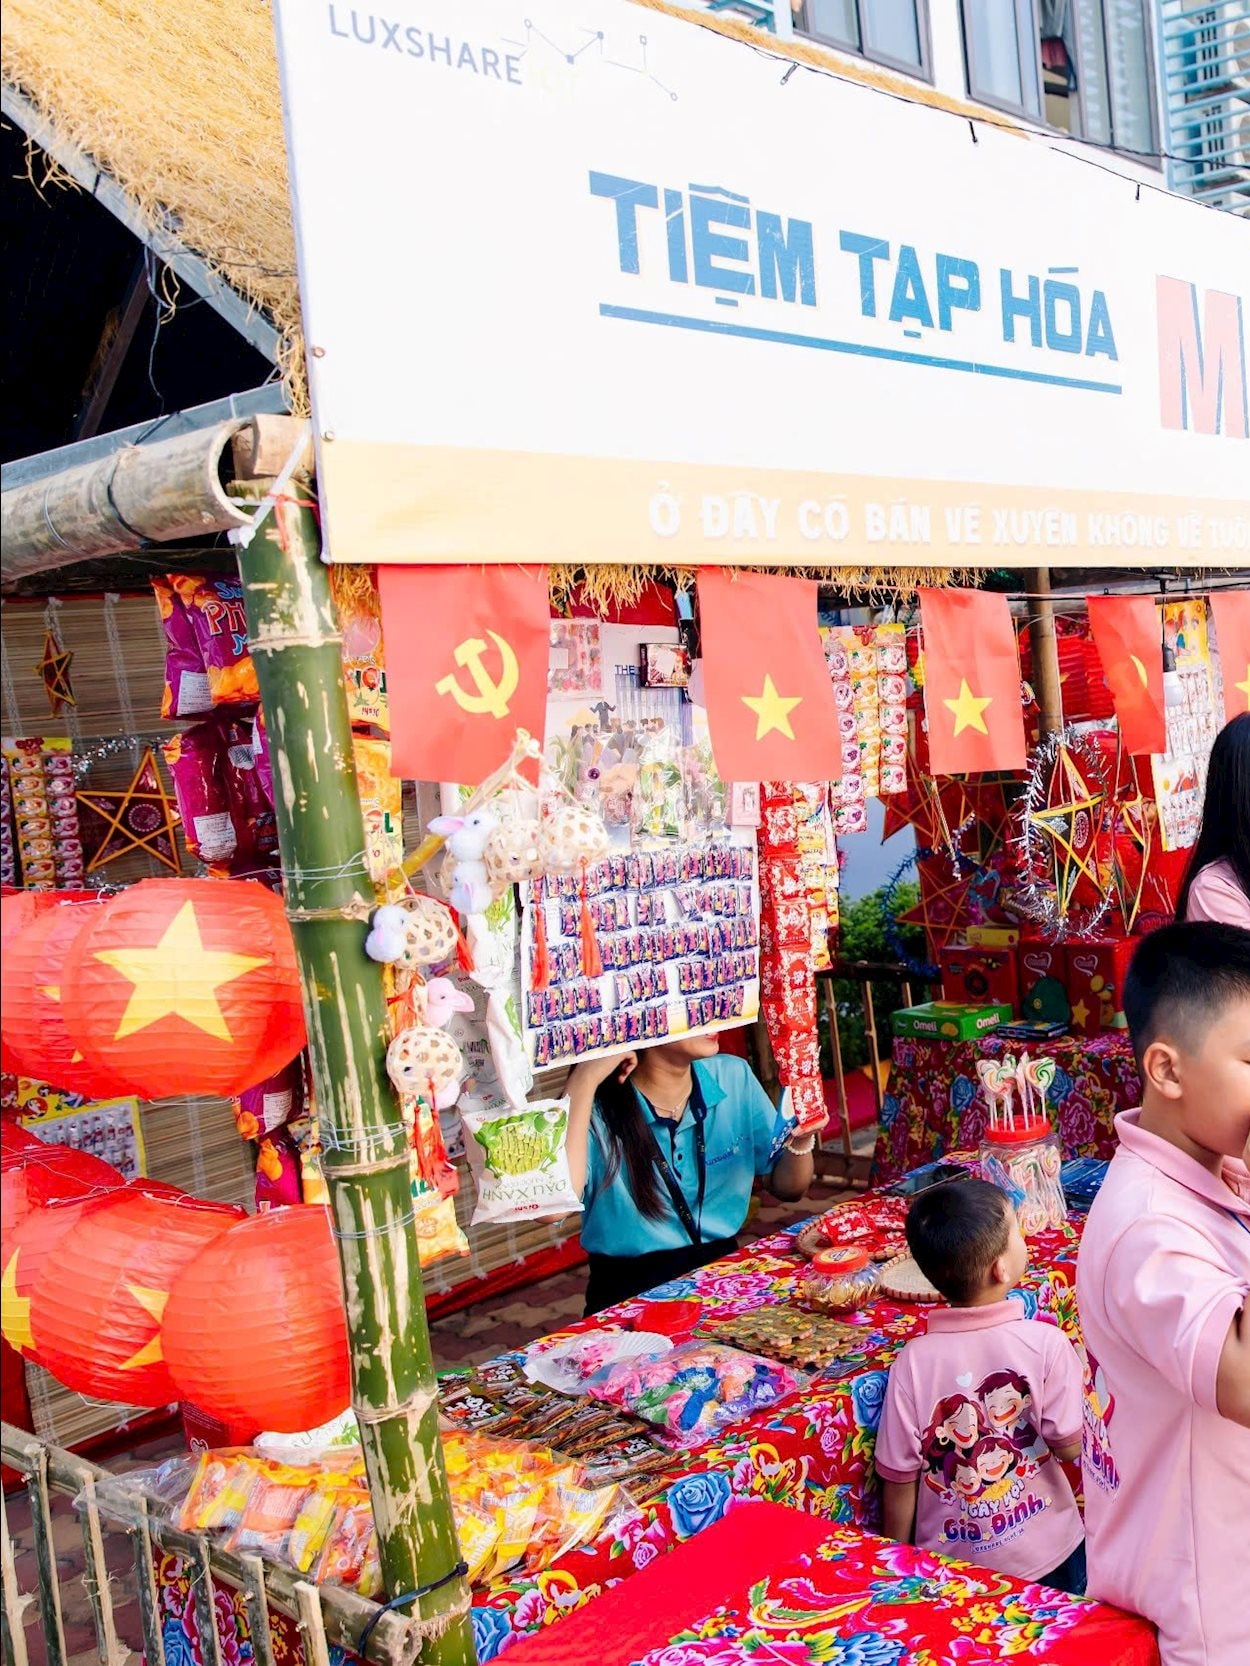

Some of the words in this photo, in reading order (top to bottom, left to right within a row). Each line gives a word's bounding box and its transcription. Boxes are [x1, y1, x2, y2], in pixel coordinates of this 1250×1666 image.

[329, 4, 523, 84] LUXSHARE
[588, 170, 818, 308] TIỆM
[839, 229, 981, 338] TẠP
[1000, 266, 1119, 362] HÓA
[649, 480, 683, 537] Ở
[699, 491, 781, 539] ĐÂY
[798, 493, 849, 539] CÓ
[864, 496, 932, 543] BÁN
[991, 505, 1078, 545] XUYÊN
[1088, 511, 1169, 547] KHÔNG
[614, 664, 635, 676] THE
[912, 1018, 938, 1032] Omeli
[976, 1012, 999, 1030] Omeli
[482, 1185, 529, 1202] XANH
[943, 1518, 983, 1543] Gia
[991, 1493, 1045, 1537] Đình
